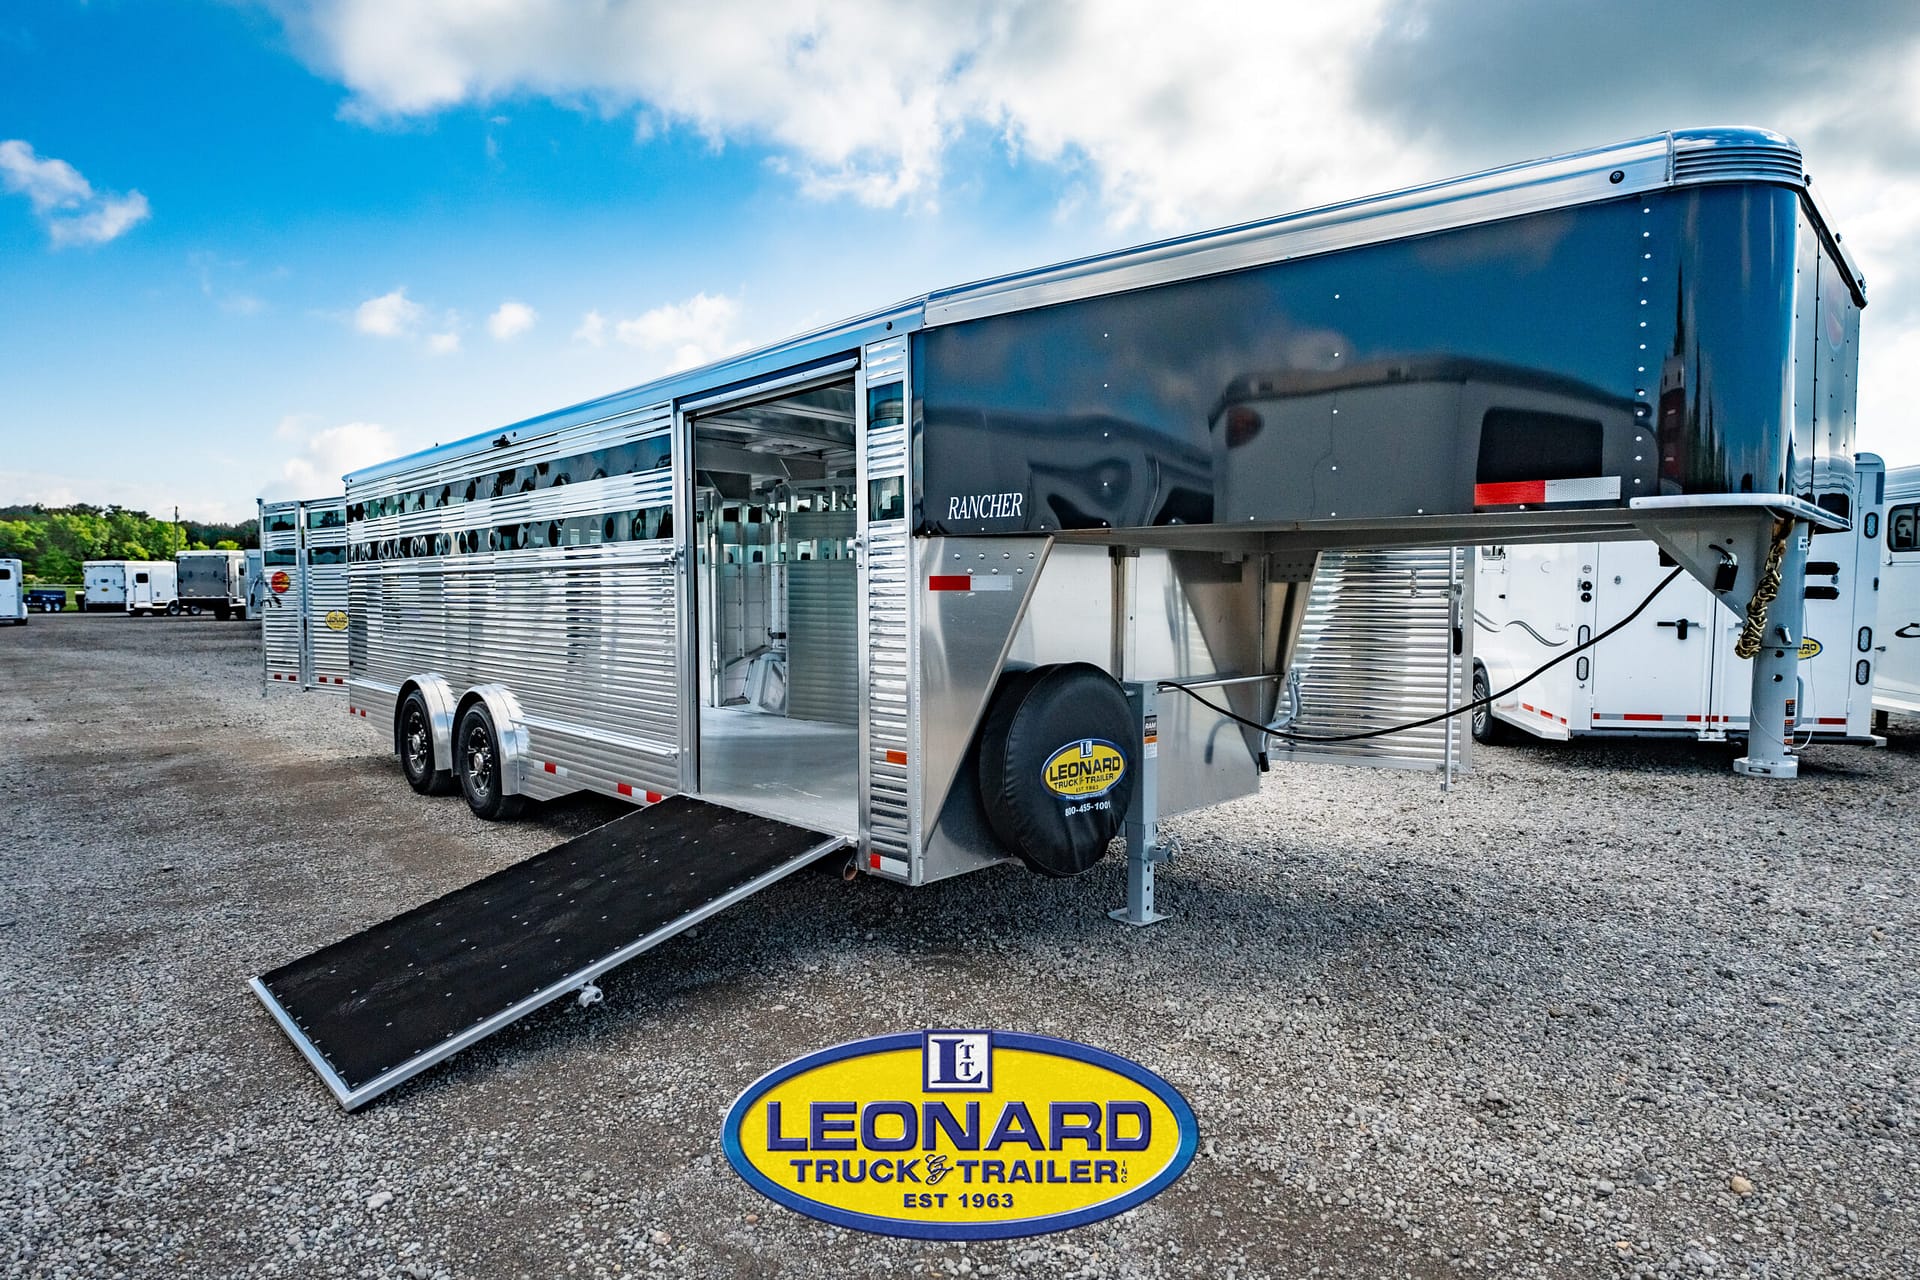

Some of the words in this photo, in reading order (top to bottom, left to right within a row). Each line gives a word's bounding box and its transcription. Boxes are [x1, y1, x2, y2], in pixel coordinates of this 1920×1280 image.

[947, 492, 1023, 520] RANCHER
[1049, 756, 1120, 782] LEONARD
[1054, 779, 1079, 789] TRUCK
[1085, 773, 1114, 784] TRAILER
